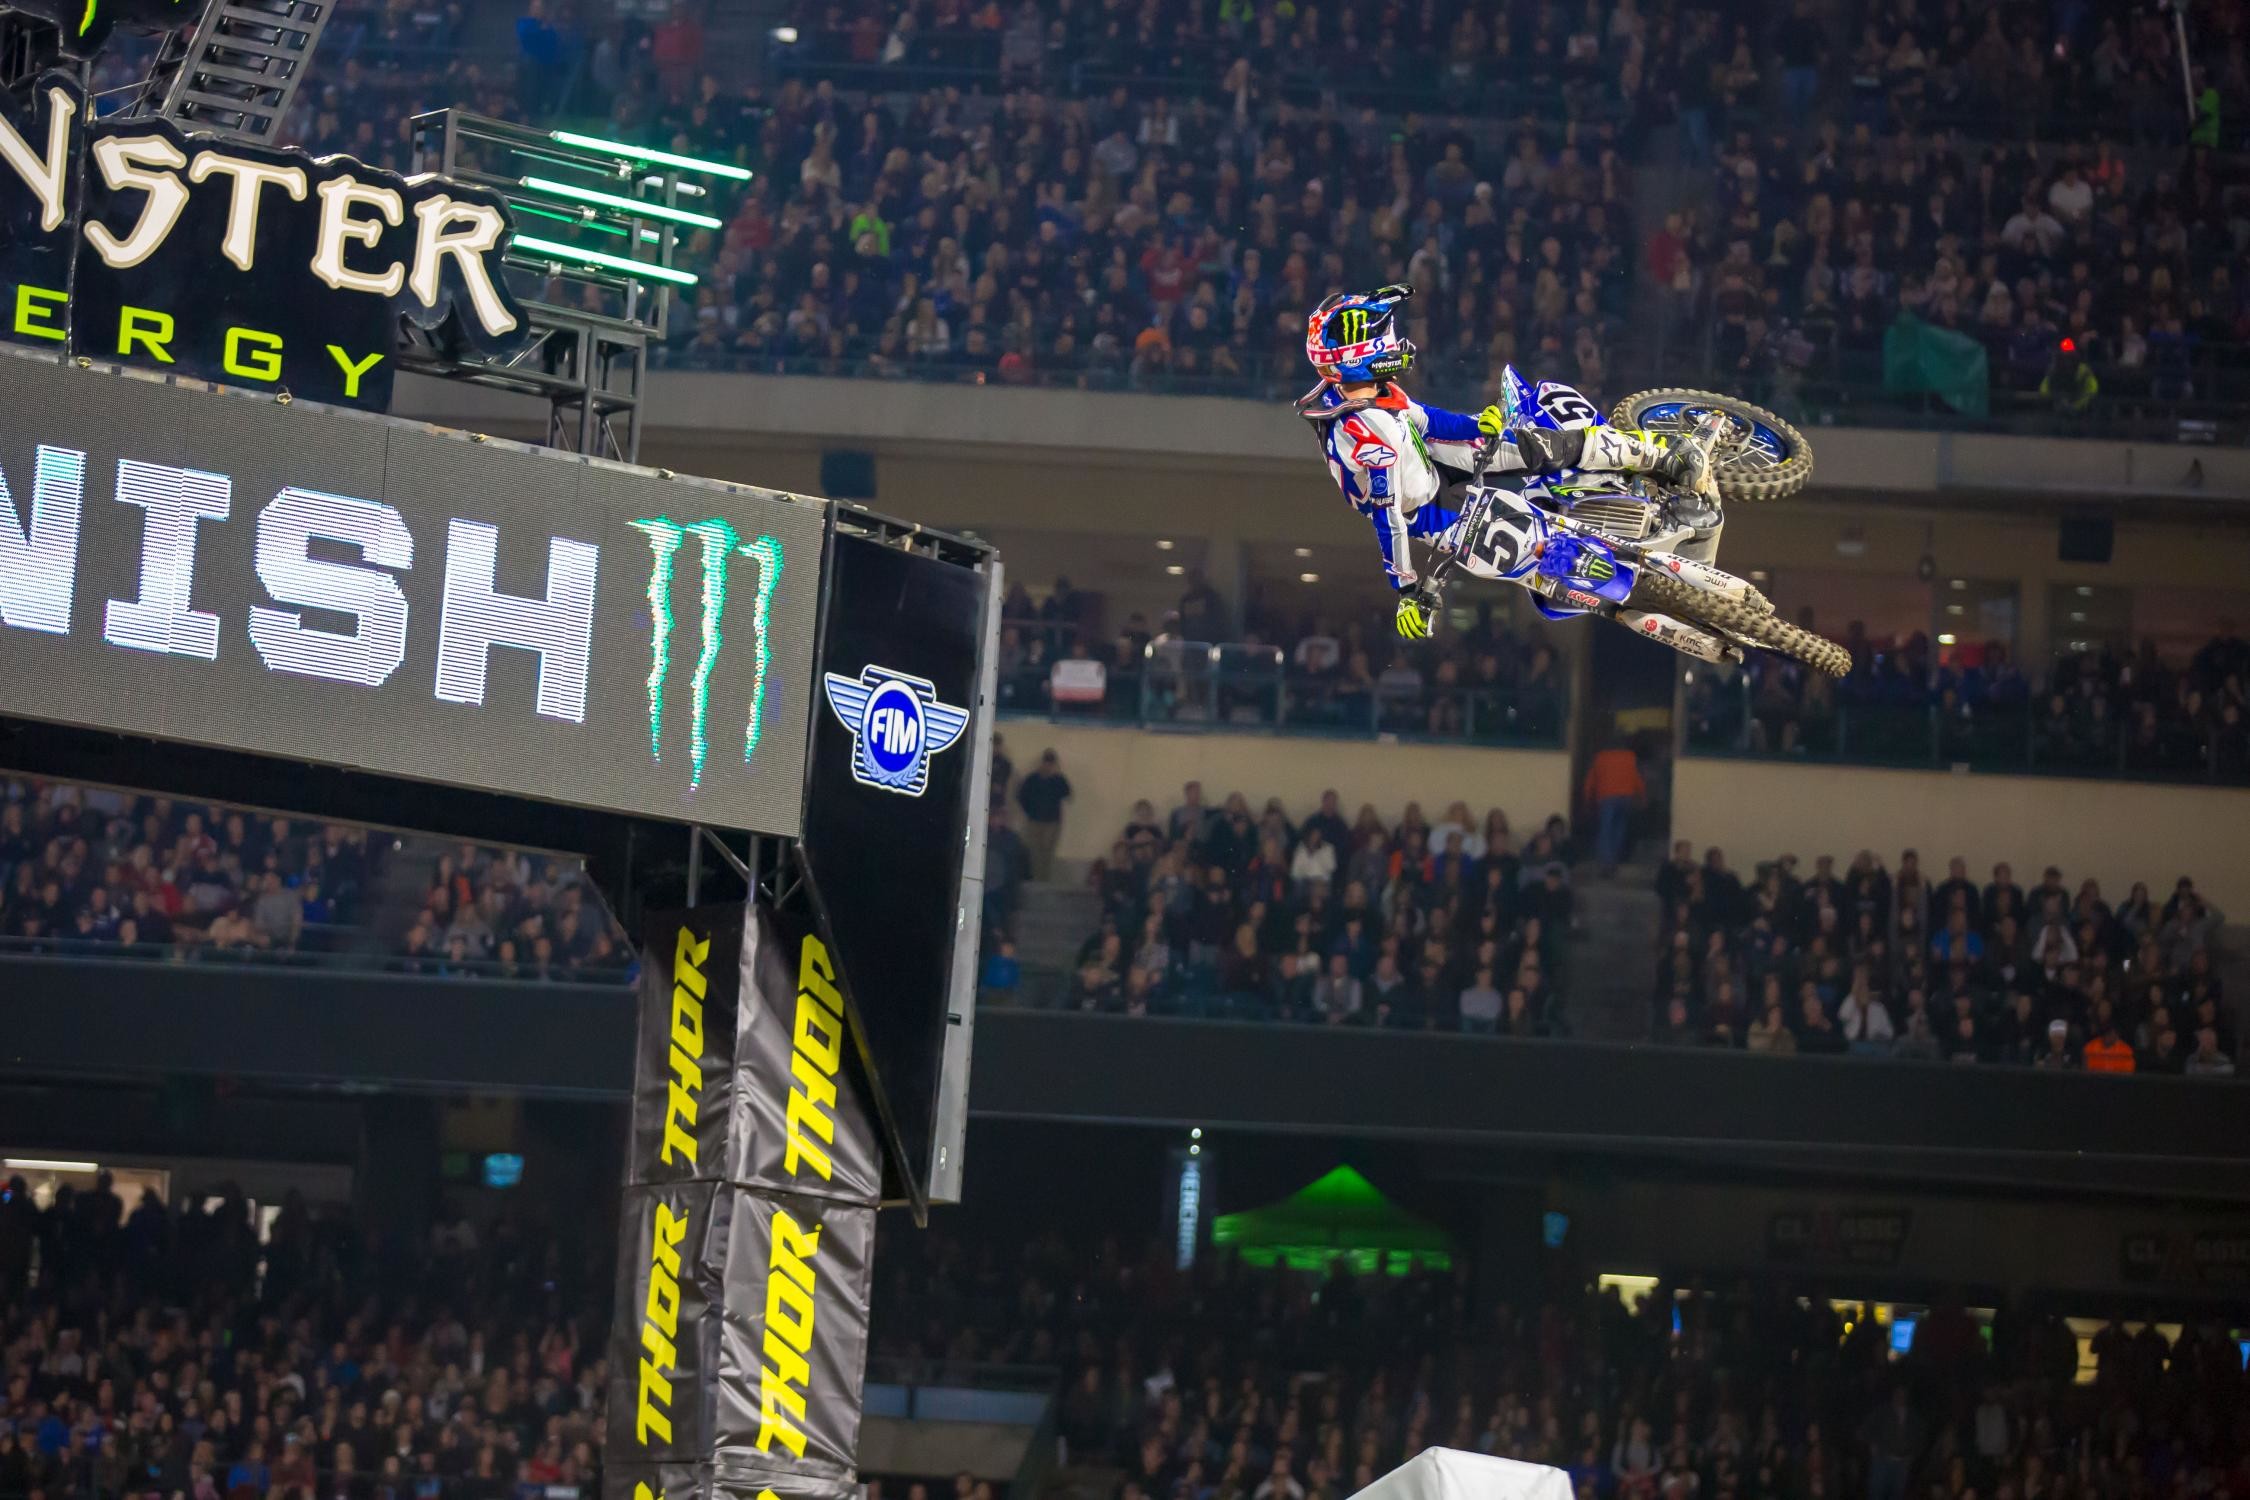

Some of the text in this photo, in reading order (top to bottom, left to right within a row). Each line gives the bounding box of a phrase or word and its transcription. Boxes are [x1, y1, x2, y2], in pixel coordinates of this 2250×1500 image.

[13, 284, 385, 398] ERGY
[1472, 495, 1534, 574] 51
[871, 708, 918, 755] FIM
[660, 925, 711, 1166] THOR
[636, 1202, 689, 1446] THOR
[755, 1209, 821, 1459] THOR
